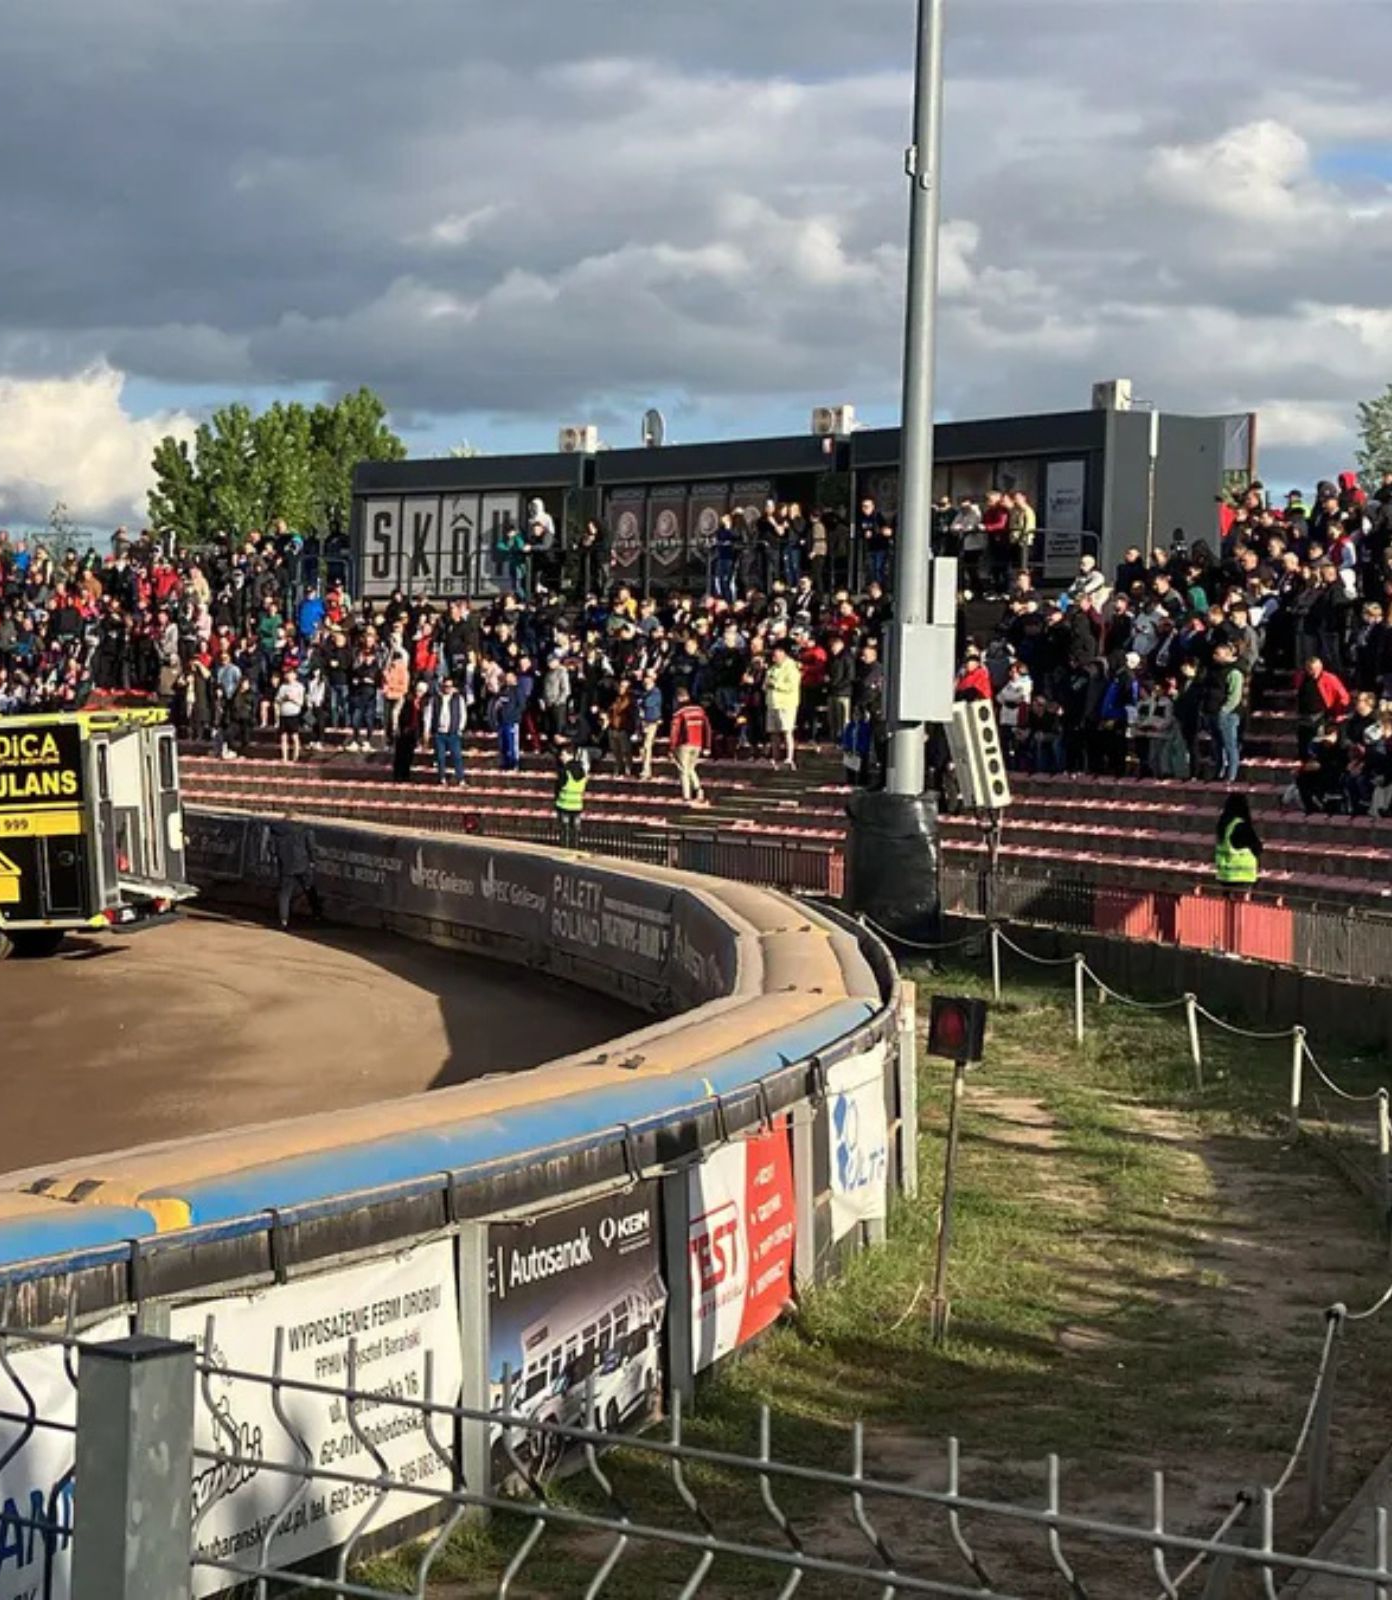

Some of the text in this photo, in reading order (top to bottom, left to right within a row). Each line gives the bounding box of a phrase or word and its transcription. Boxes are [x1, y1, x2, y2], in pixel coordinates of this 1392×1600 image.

[3, 818, 29, 831] 999
[553, 874, 603, 912] PALETY
[288, 1284, 442, 1352] WYPOSAŻENIE FERM DROBIU
